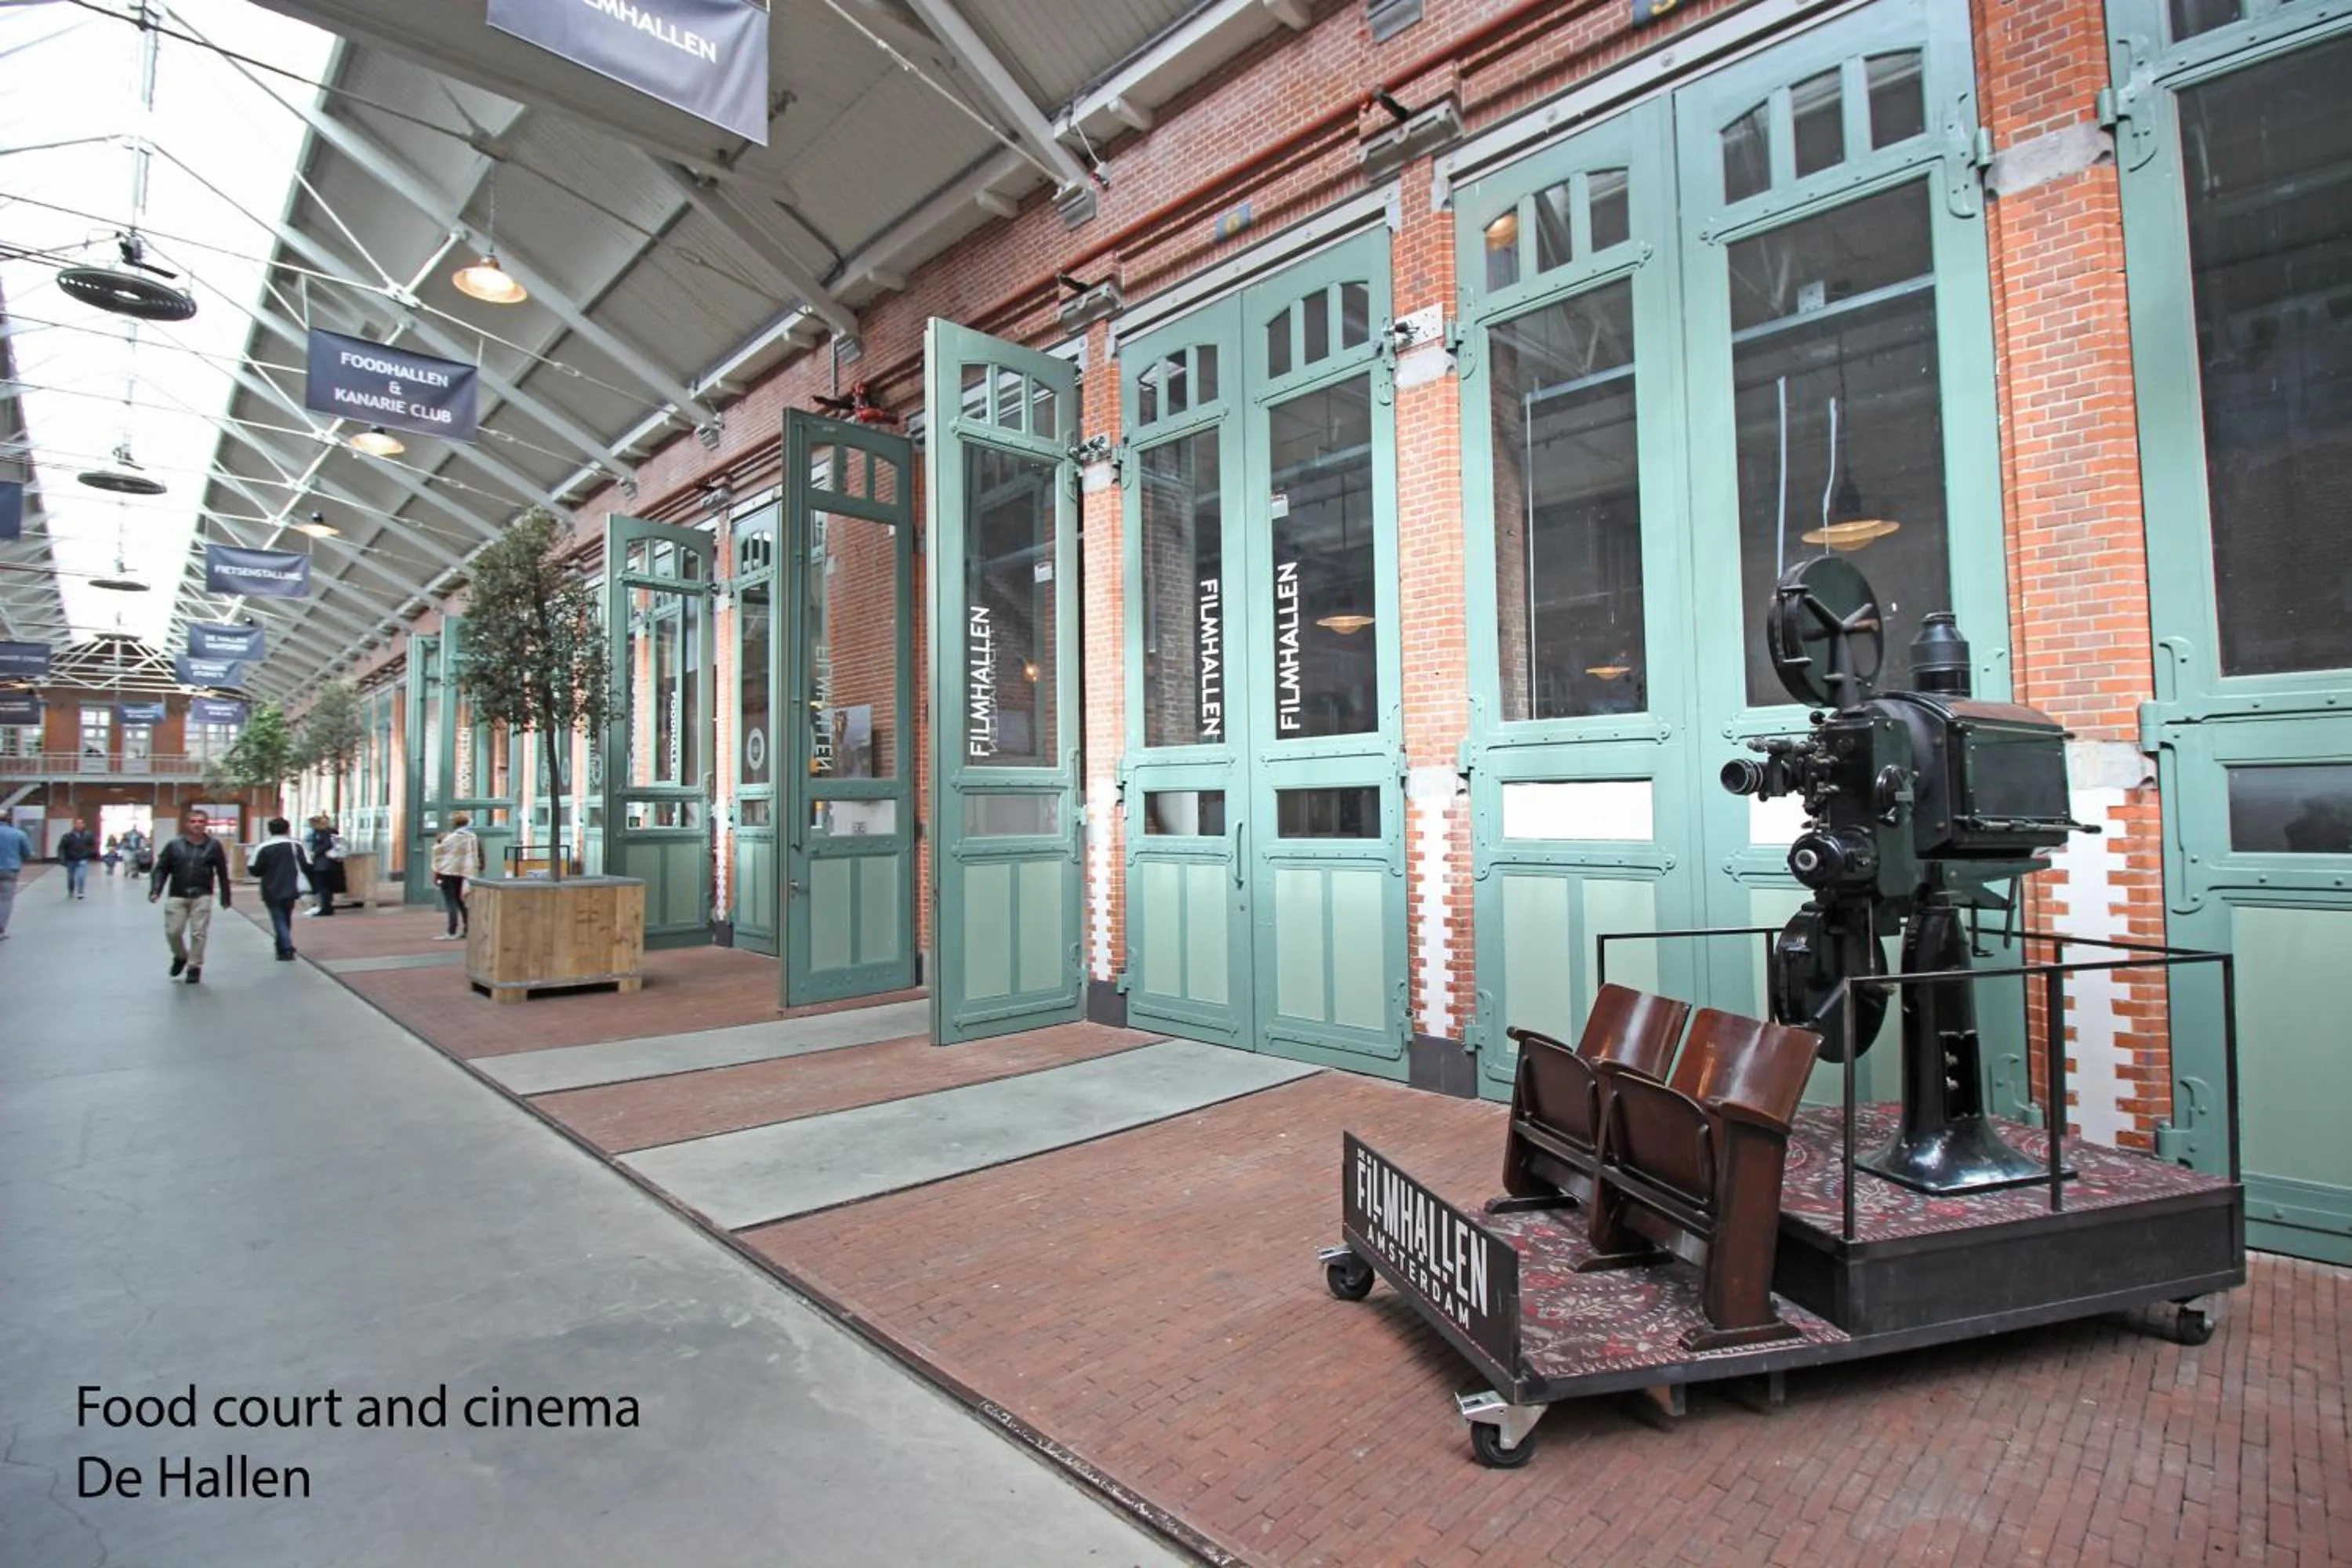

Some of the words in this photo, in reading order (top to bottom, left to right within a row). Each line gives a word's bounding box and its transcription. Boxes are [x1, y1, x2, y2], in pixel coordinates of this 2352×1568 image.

[334, 387, 406, 414] KANARIE
[409, 403, 452, 423] CLUB
[340, 351, 448, 387] FOODHALLEN
[388, 381, 402, 395] &
[970, 605, 992, 757] FILMHALLEN
[1200, 579, 1222, 736] FILMHALLEN
[1277, 561, 1301, 731] FILMHALLEN
[1367, 1223, 1471, 1330] AMSTERDAM
